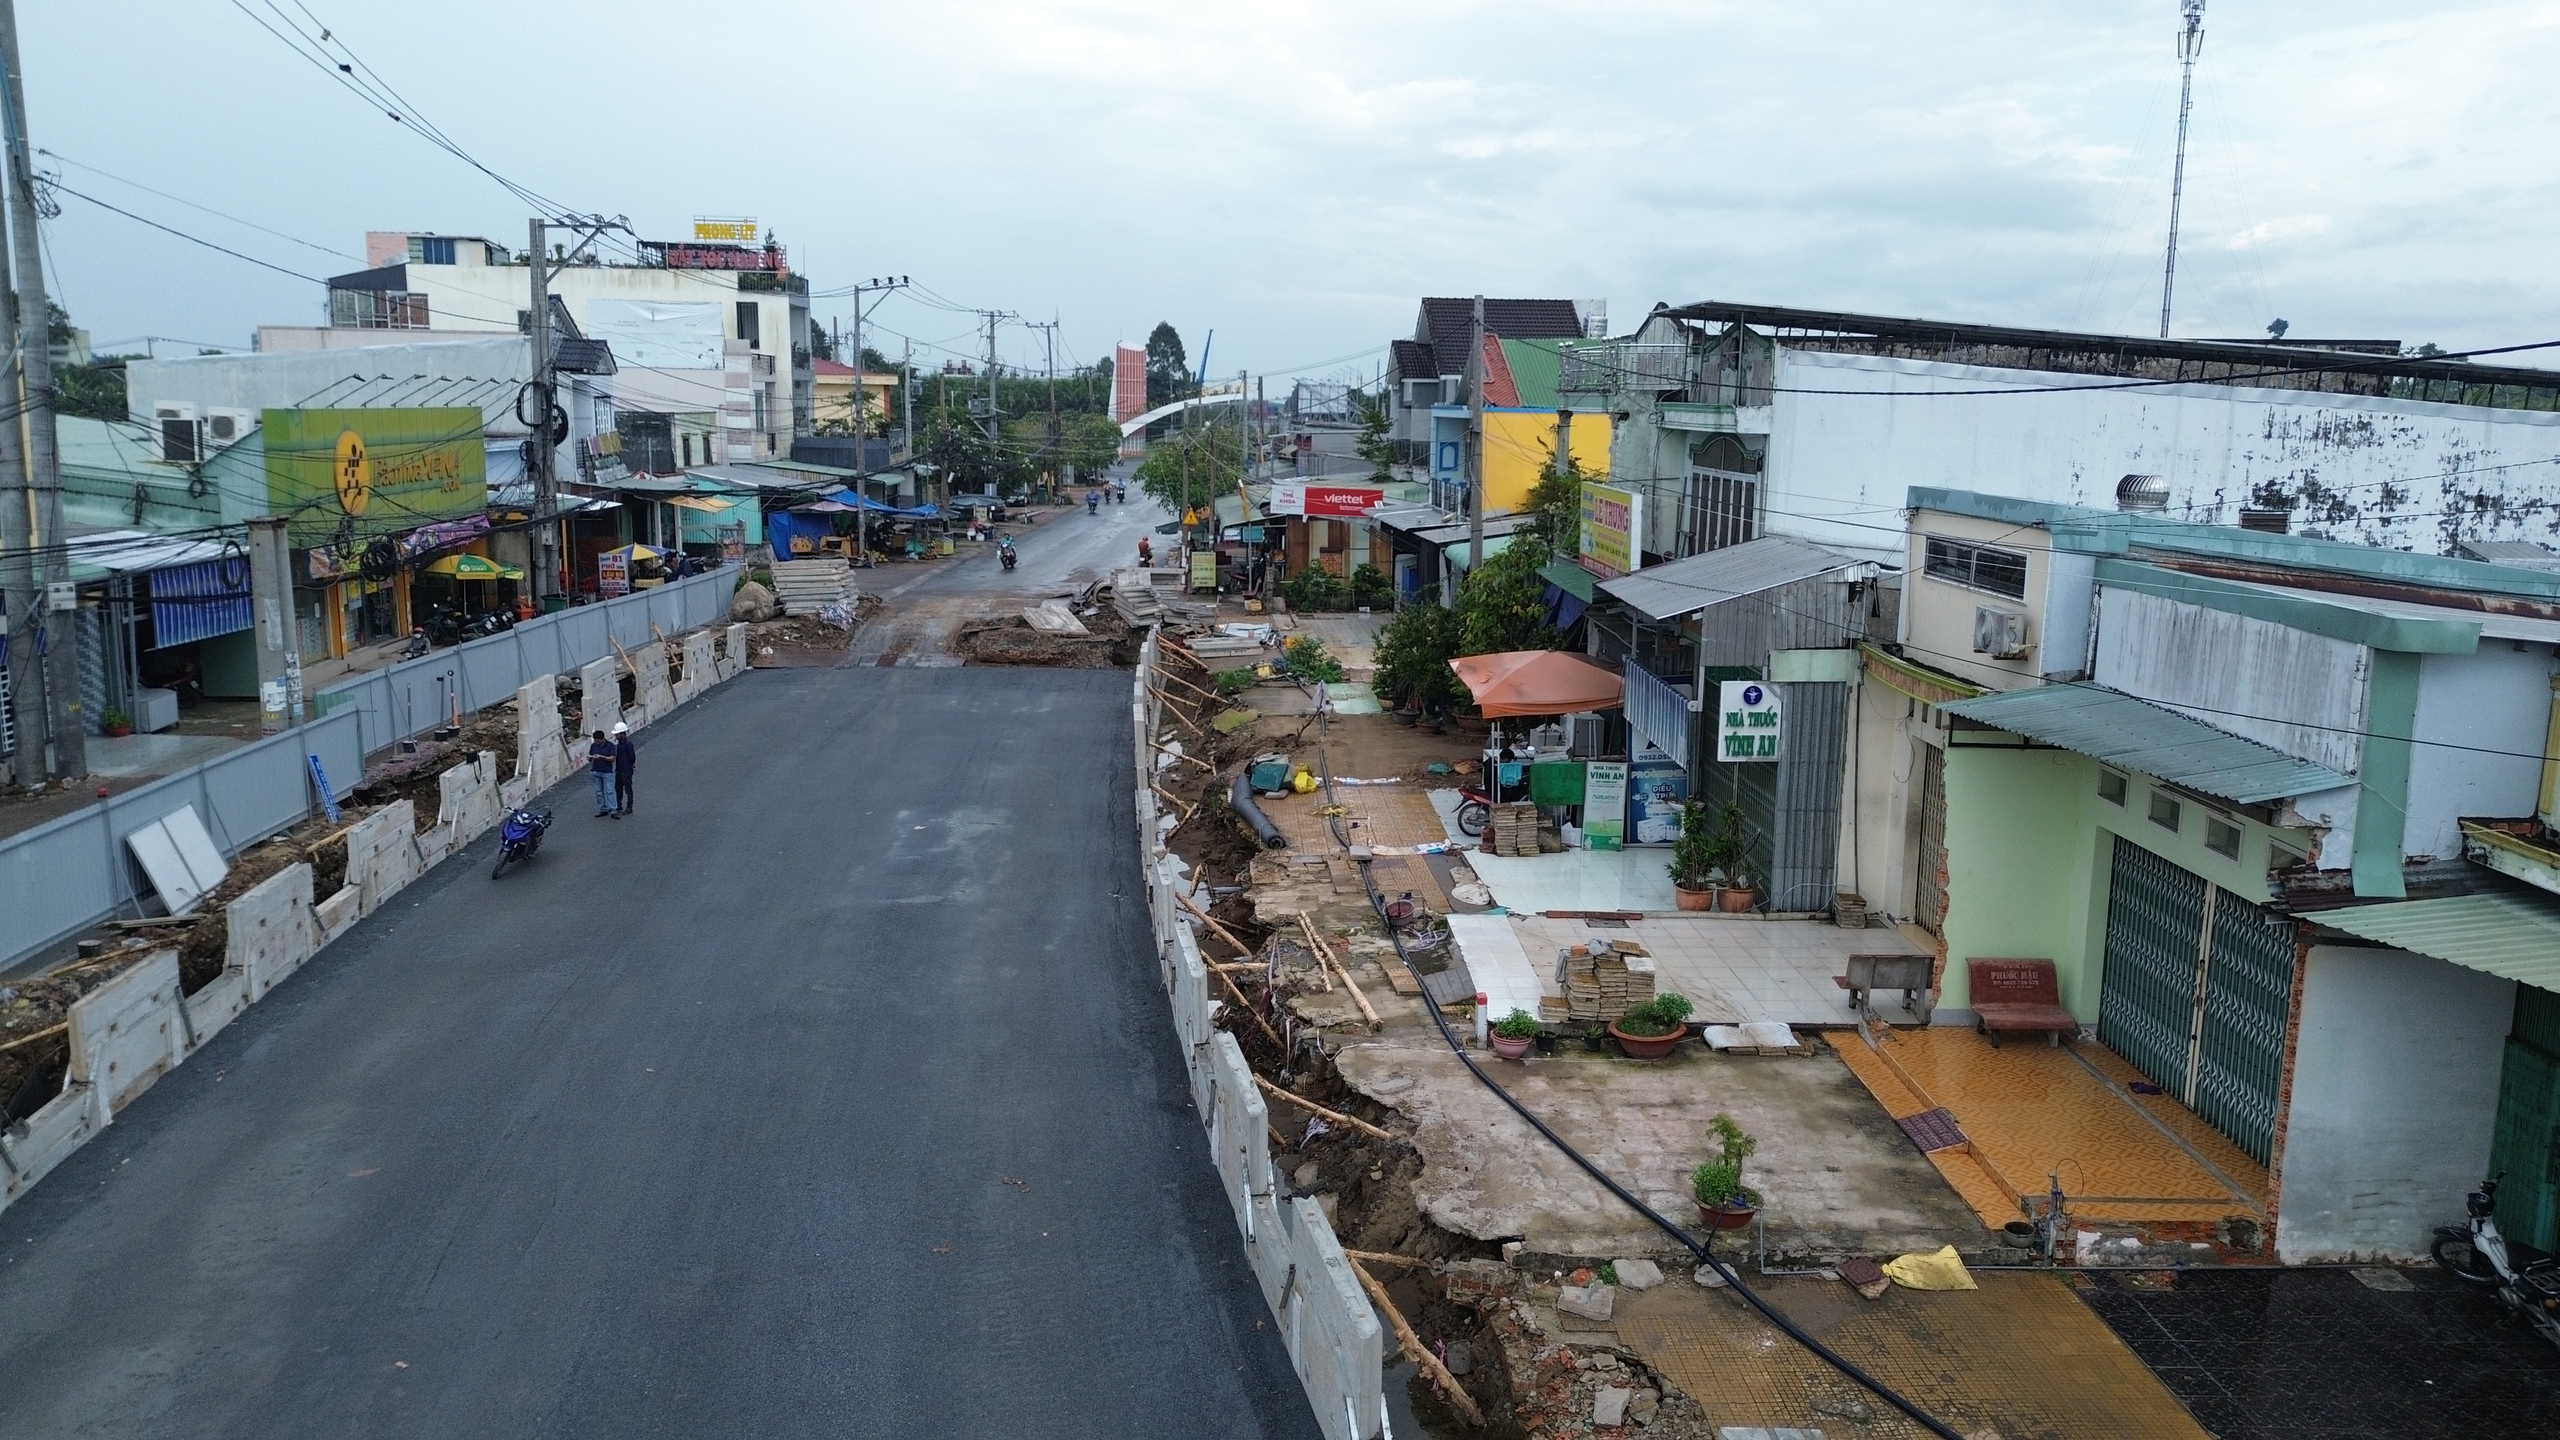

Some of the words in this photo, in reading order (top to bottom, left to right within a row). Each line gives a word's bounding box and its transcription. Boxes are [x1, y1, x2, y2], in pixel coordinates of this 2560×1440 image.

[695, 223, 737, 240] PHONG
[1324, 493, 1364, 504] viettel
[1725, 707, 1745, 727] NHÀ
[1747, 704, 1778, 727] THUỐC
[1757, 734, 1777, 757] AN
[1612, 772, 1625, 780] AN
